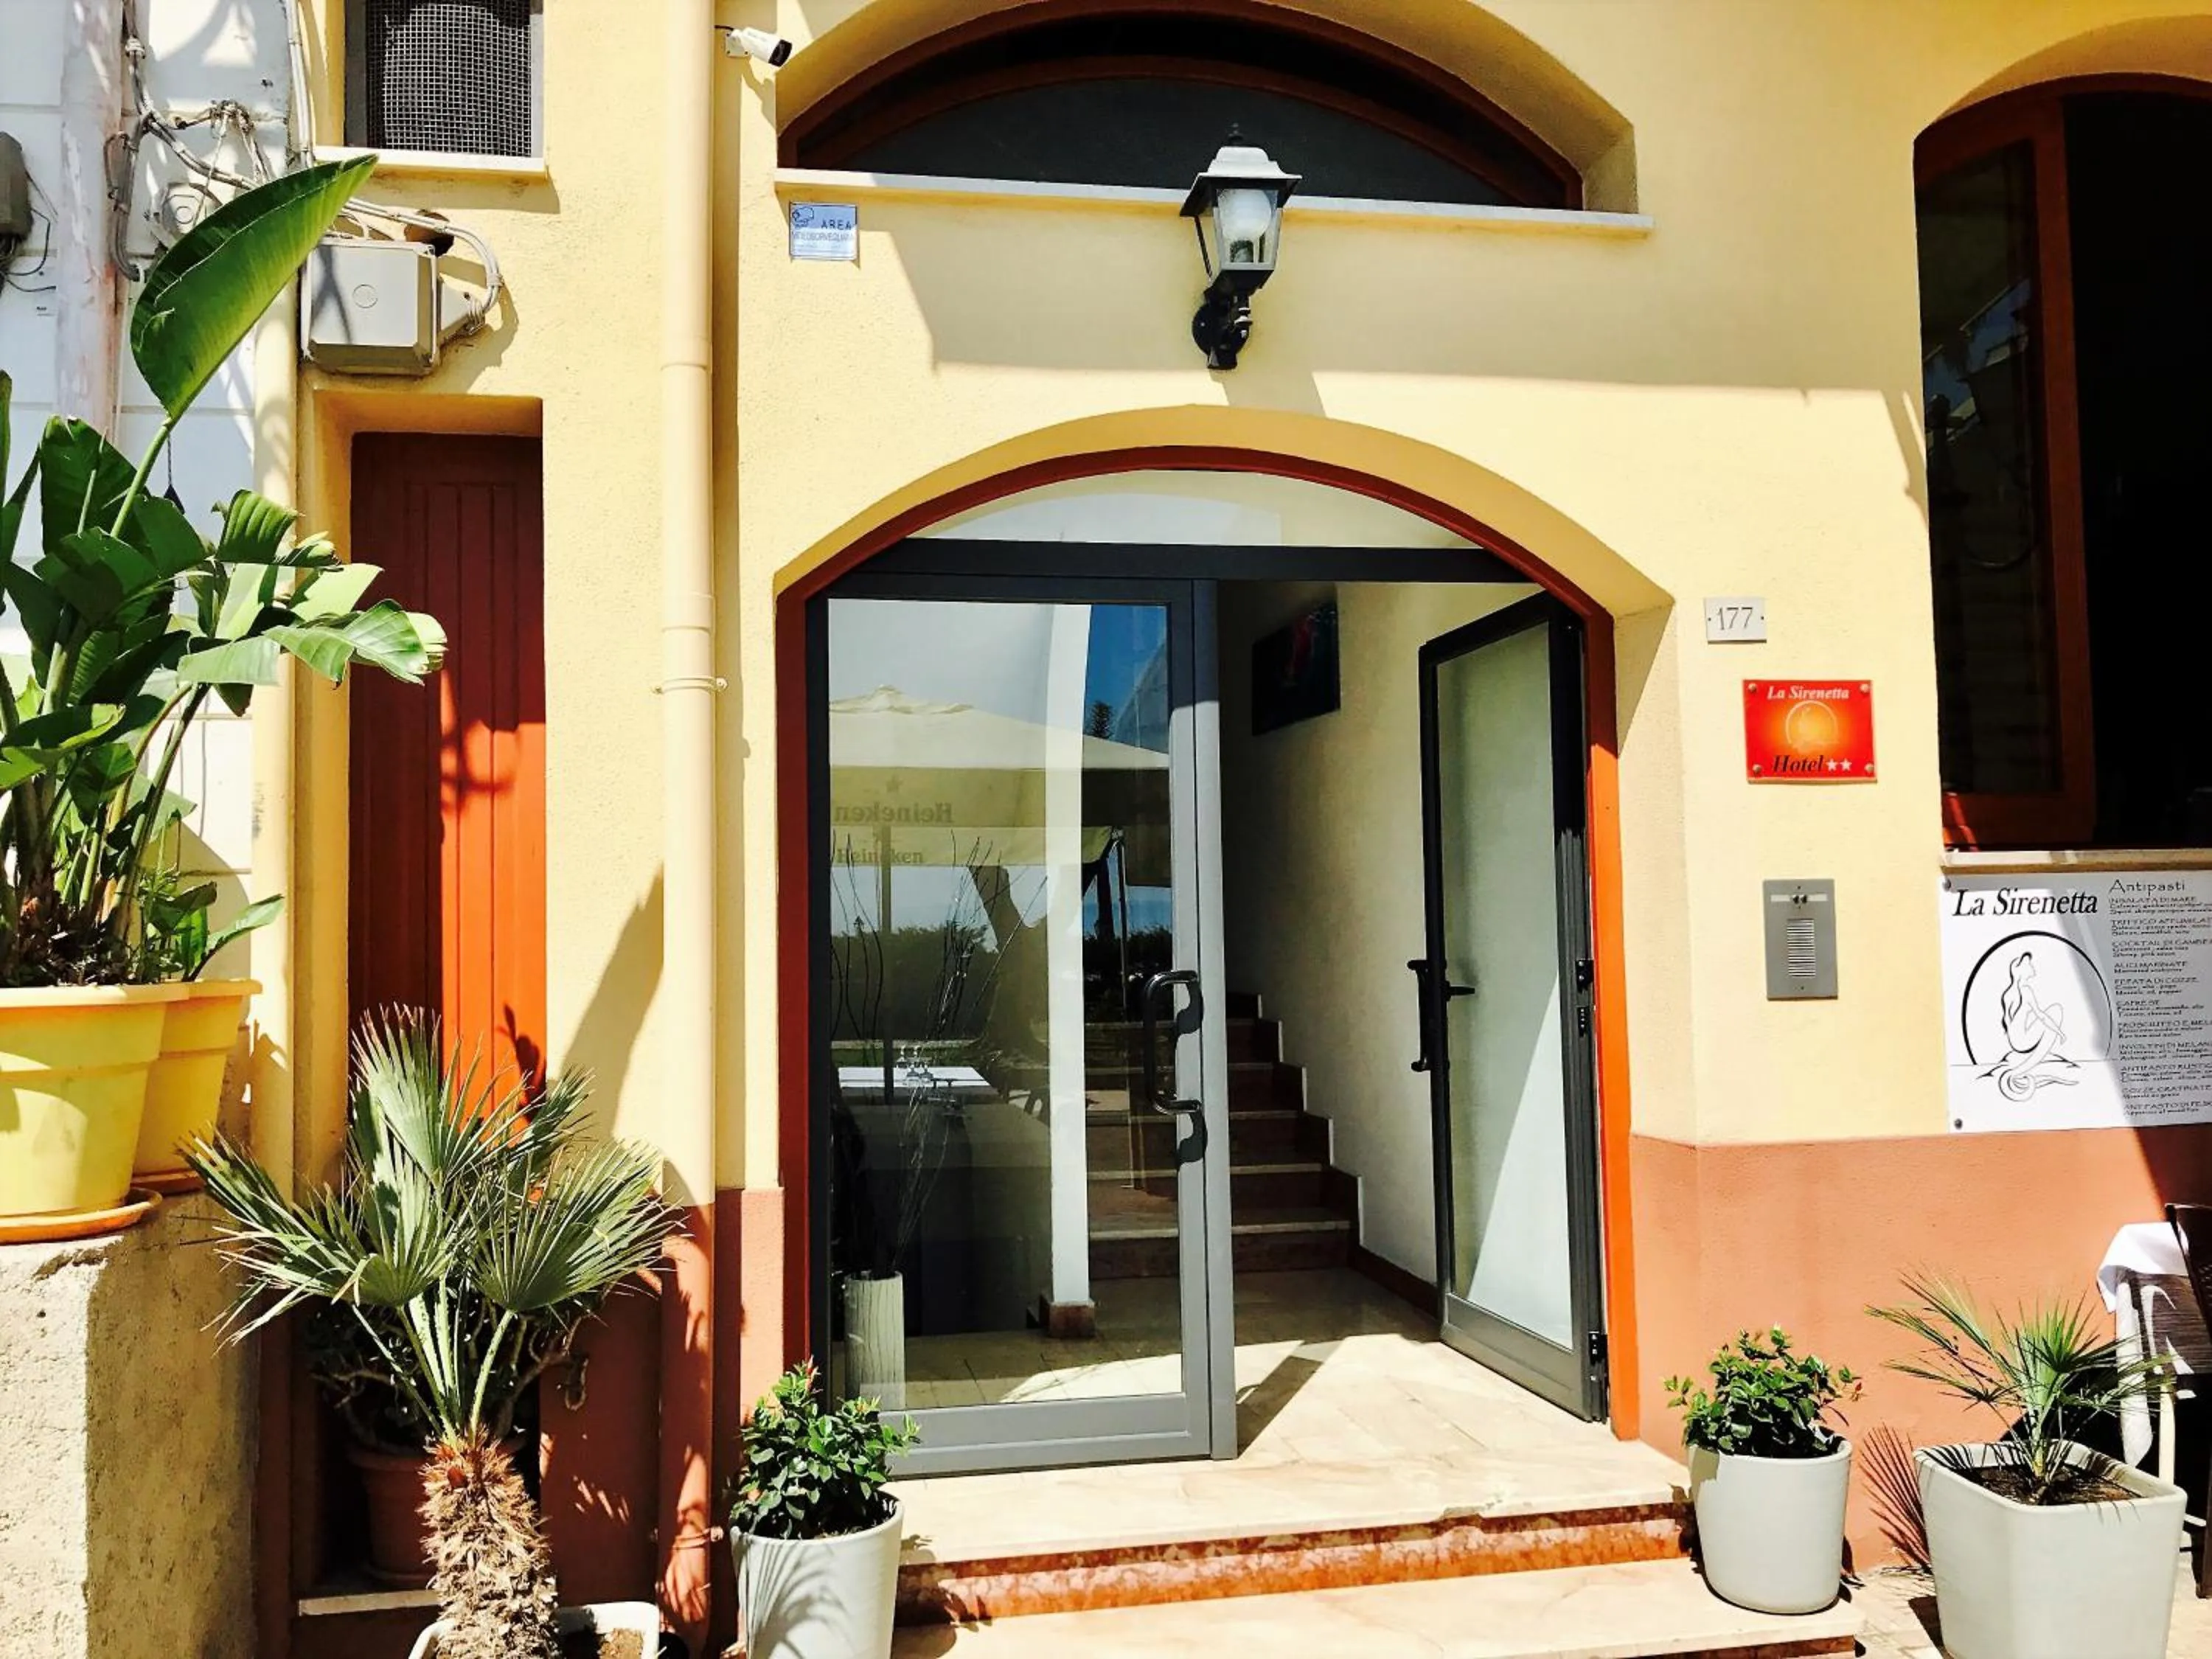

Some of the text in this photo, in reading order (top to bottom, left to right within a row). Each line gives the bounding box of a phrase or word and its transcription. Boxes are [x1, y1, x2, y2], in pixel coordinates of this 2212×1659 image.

[821, 218, 852, 231] AREA
[1717, 607, 1753, 630] 177
[1767, 684, 1850, 699] La Sirenetta
[1772, 754, 1825, 773] Hotel
[836, 848, 923, 863] Heinken
[2109, 879, 2185, 897] Antipasti
[1952, 887, 2098, 917] La Sirenetta
